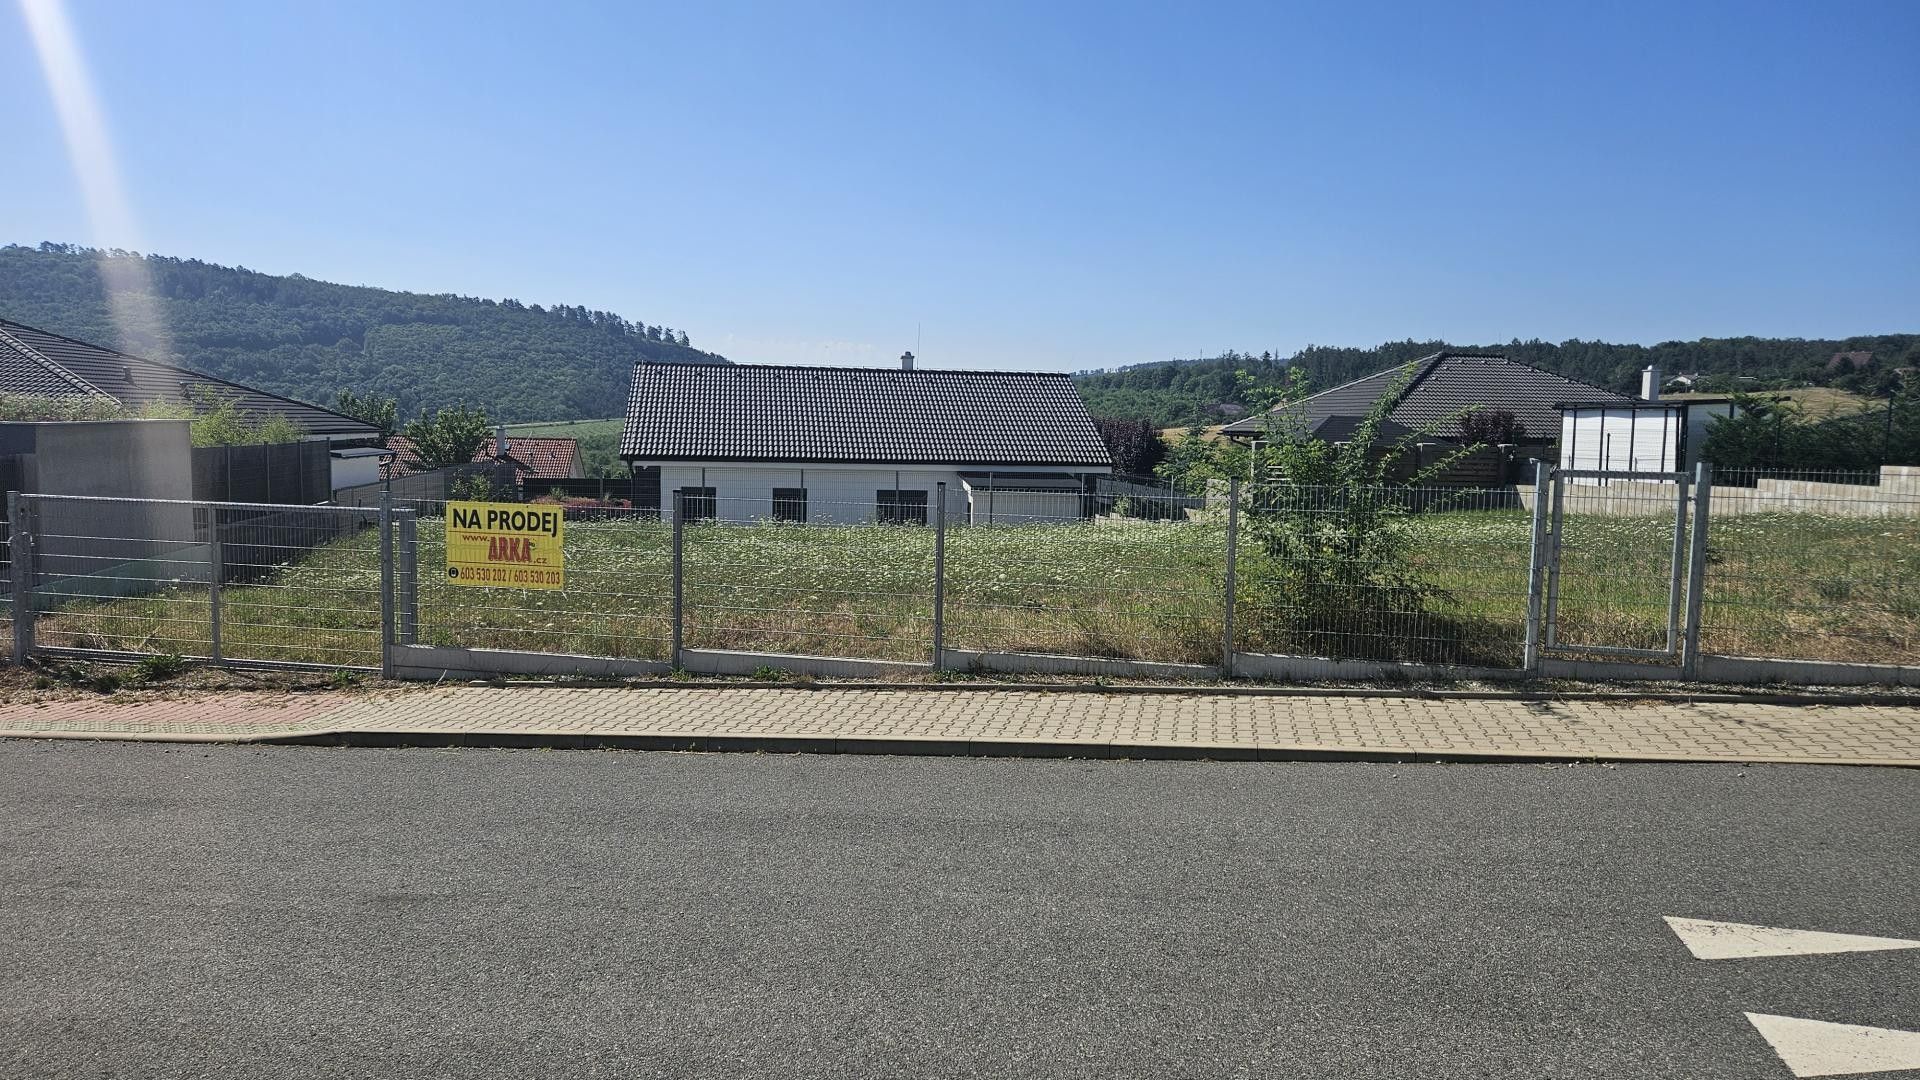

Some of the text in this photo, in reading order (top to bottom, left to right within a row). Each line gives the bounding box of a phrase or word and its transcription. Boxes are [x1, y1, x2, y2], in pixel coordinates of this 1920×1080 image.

[453, 508, 558, 538] NA PRODEJ
[460, 567, 475, 580] 603
[476, 568, 491, 582] 530
[492, 569, 507, 582] 202
[514, 570, 528, 583] 603
[530, 571, 544, 584] 530
[546, 572, 561, 585] 203
